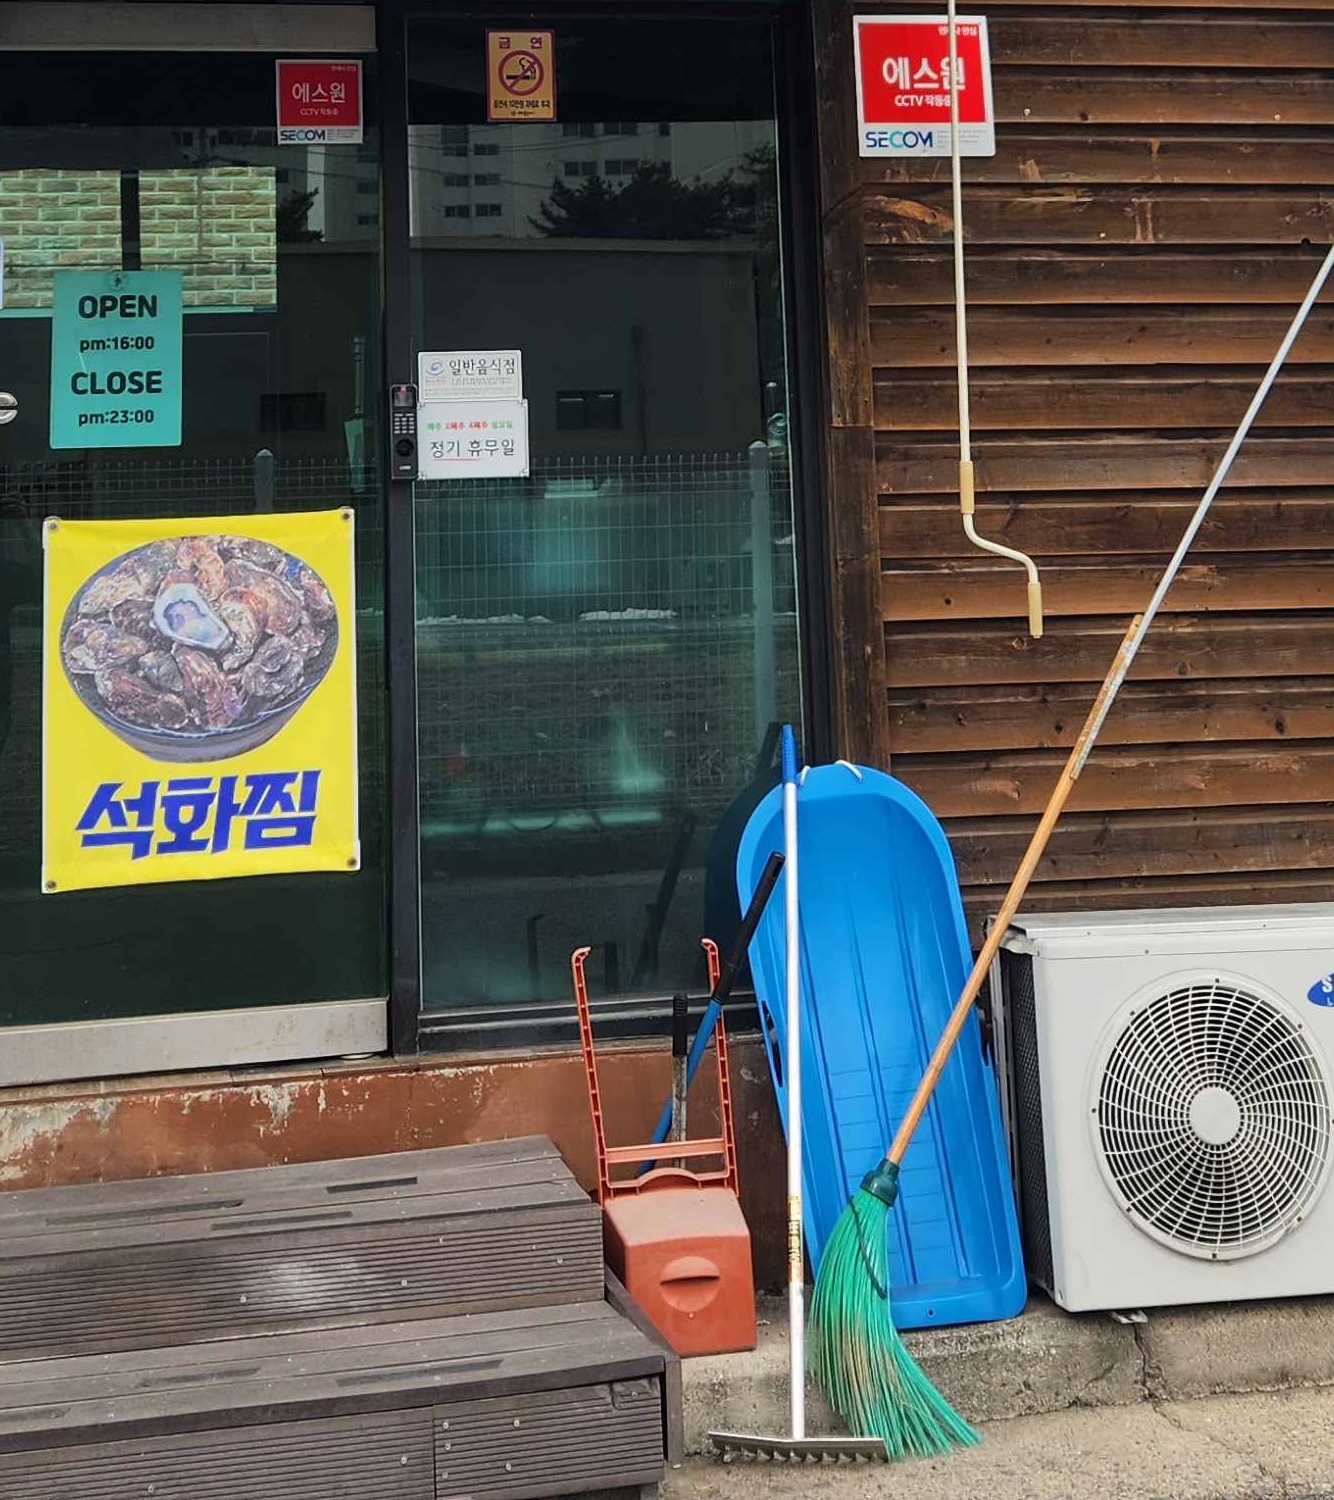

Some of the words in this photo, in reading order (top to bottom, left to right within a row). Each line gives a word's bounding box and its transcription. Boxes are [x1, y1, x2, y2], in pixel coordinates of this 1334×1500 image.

[291, 82, 346, 103] 에스원
[895, 94, 924, 107] CCTV
[280, 129, 326, 141] SECOM
[865, 130, 934, 149] SECOM
[78, 294, 158, 319] OPEN
[79, 335, 155, 354] pm:16:00
[448, 358, 516, 376] 일반음식점
[70, 370, 163, 395] CLOSE
[78, 409, 155, 428] pm:23:00
[430, 440, 461, 459] 정기
[467, 438, 516, 457] 휴무일
[74, 769, 323, 861] 석화찜
